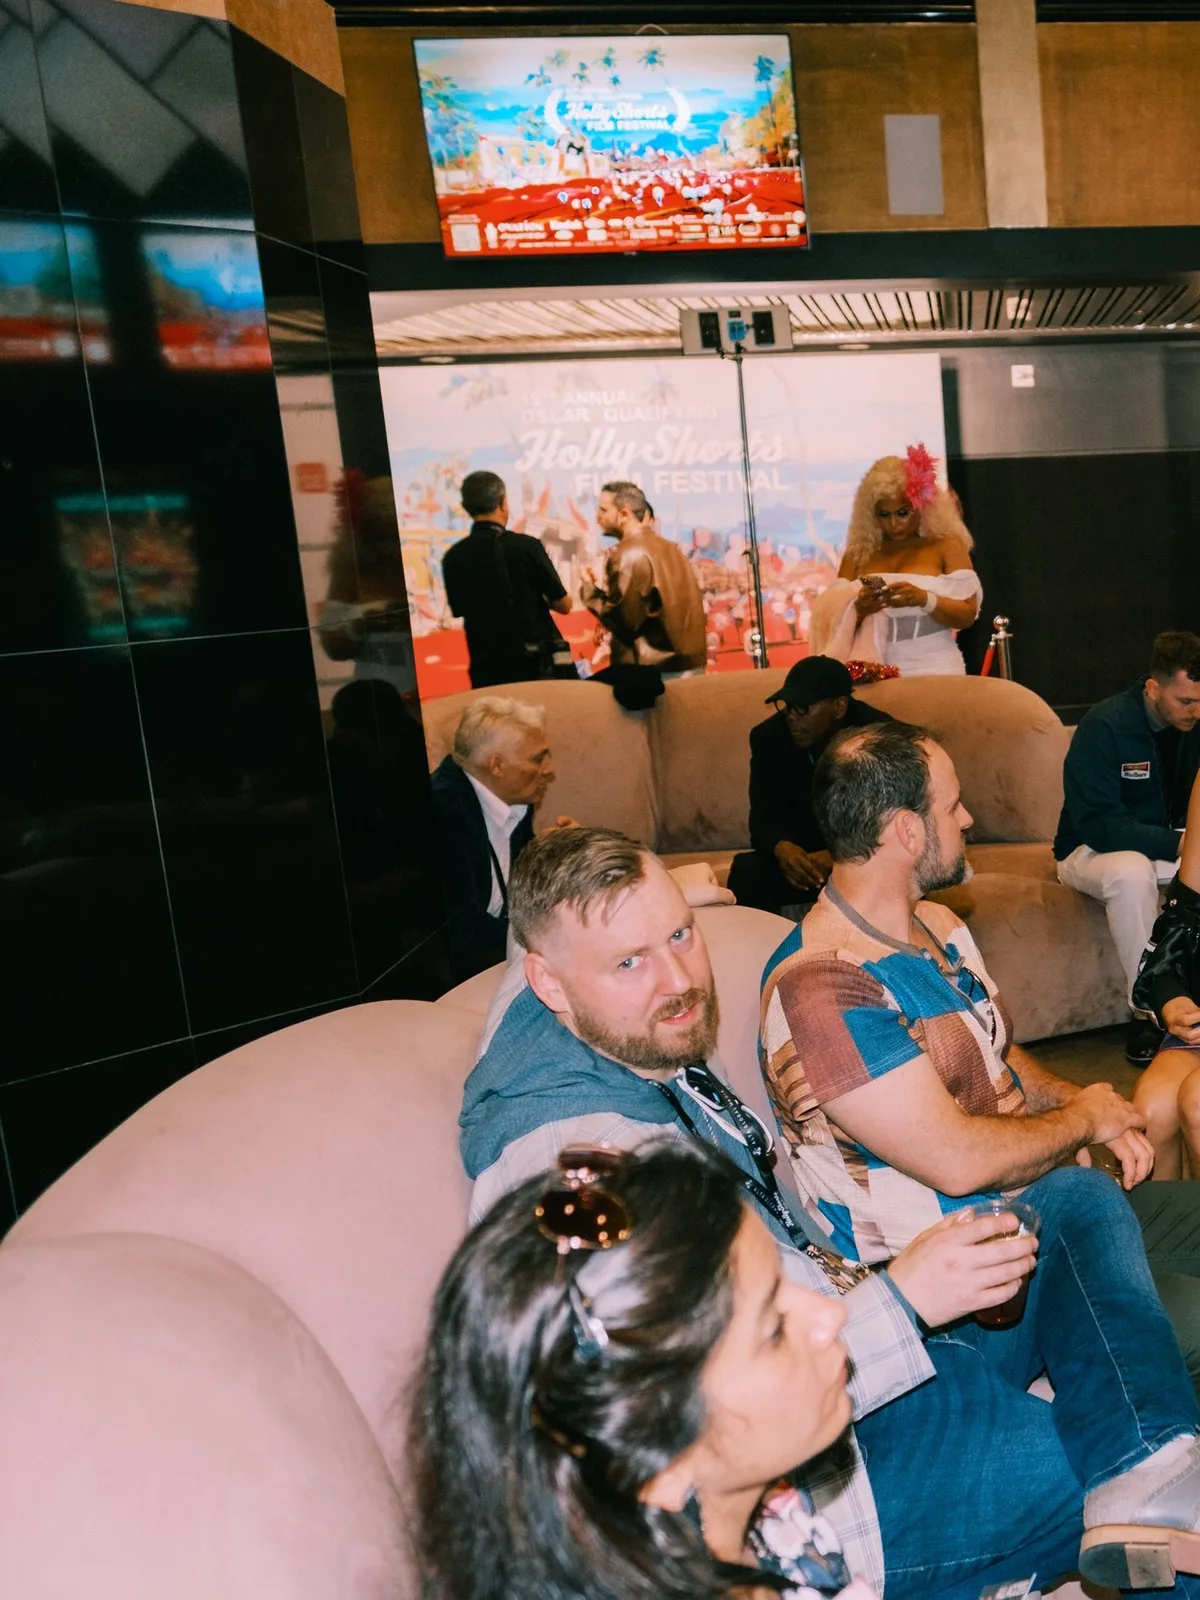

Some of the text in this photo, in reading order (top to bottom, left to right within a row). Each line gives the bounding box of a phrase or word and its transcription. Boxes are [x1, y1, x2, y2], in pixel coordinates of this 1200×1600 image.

[563, 389, 641, 406] ANNUAL
[521, 404, 719, 424] OSCAR QUALIFYING
